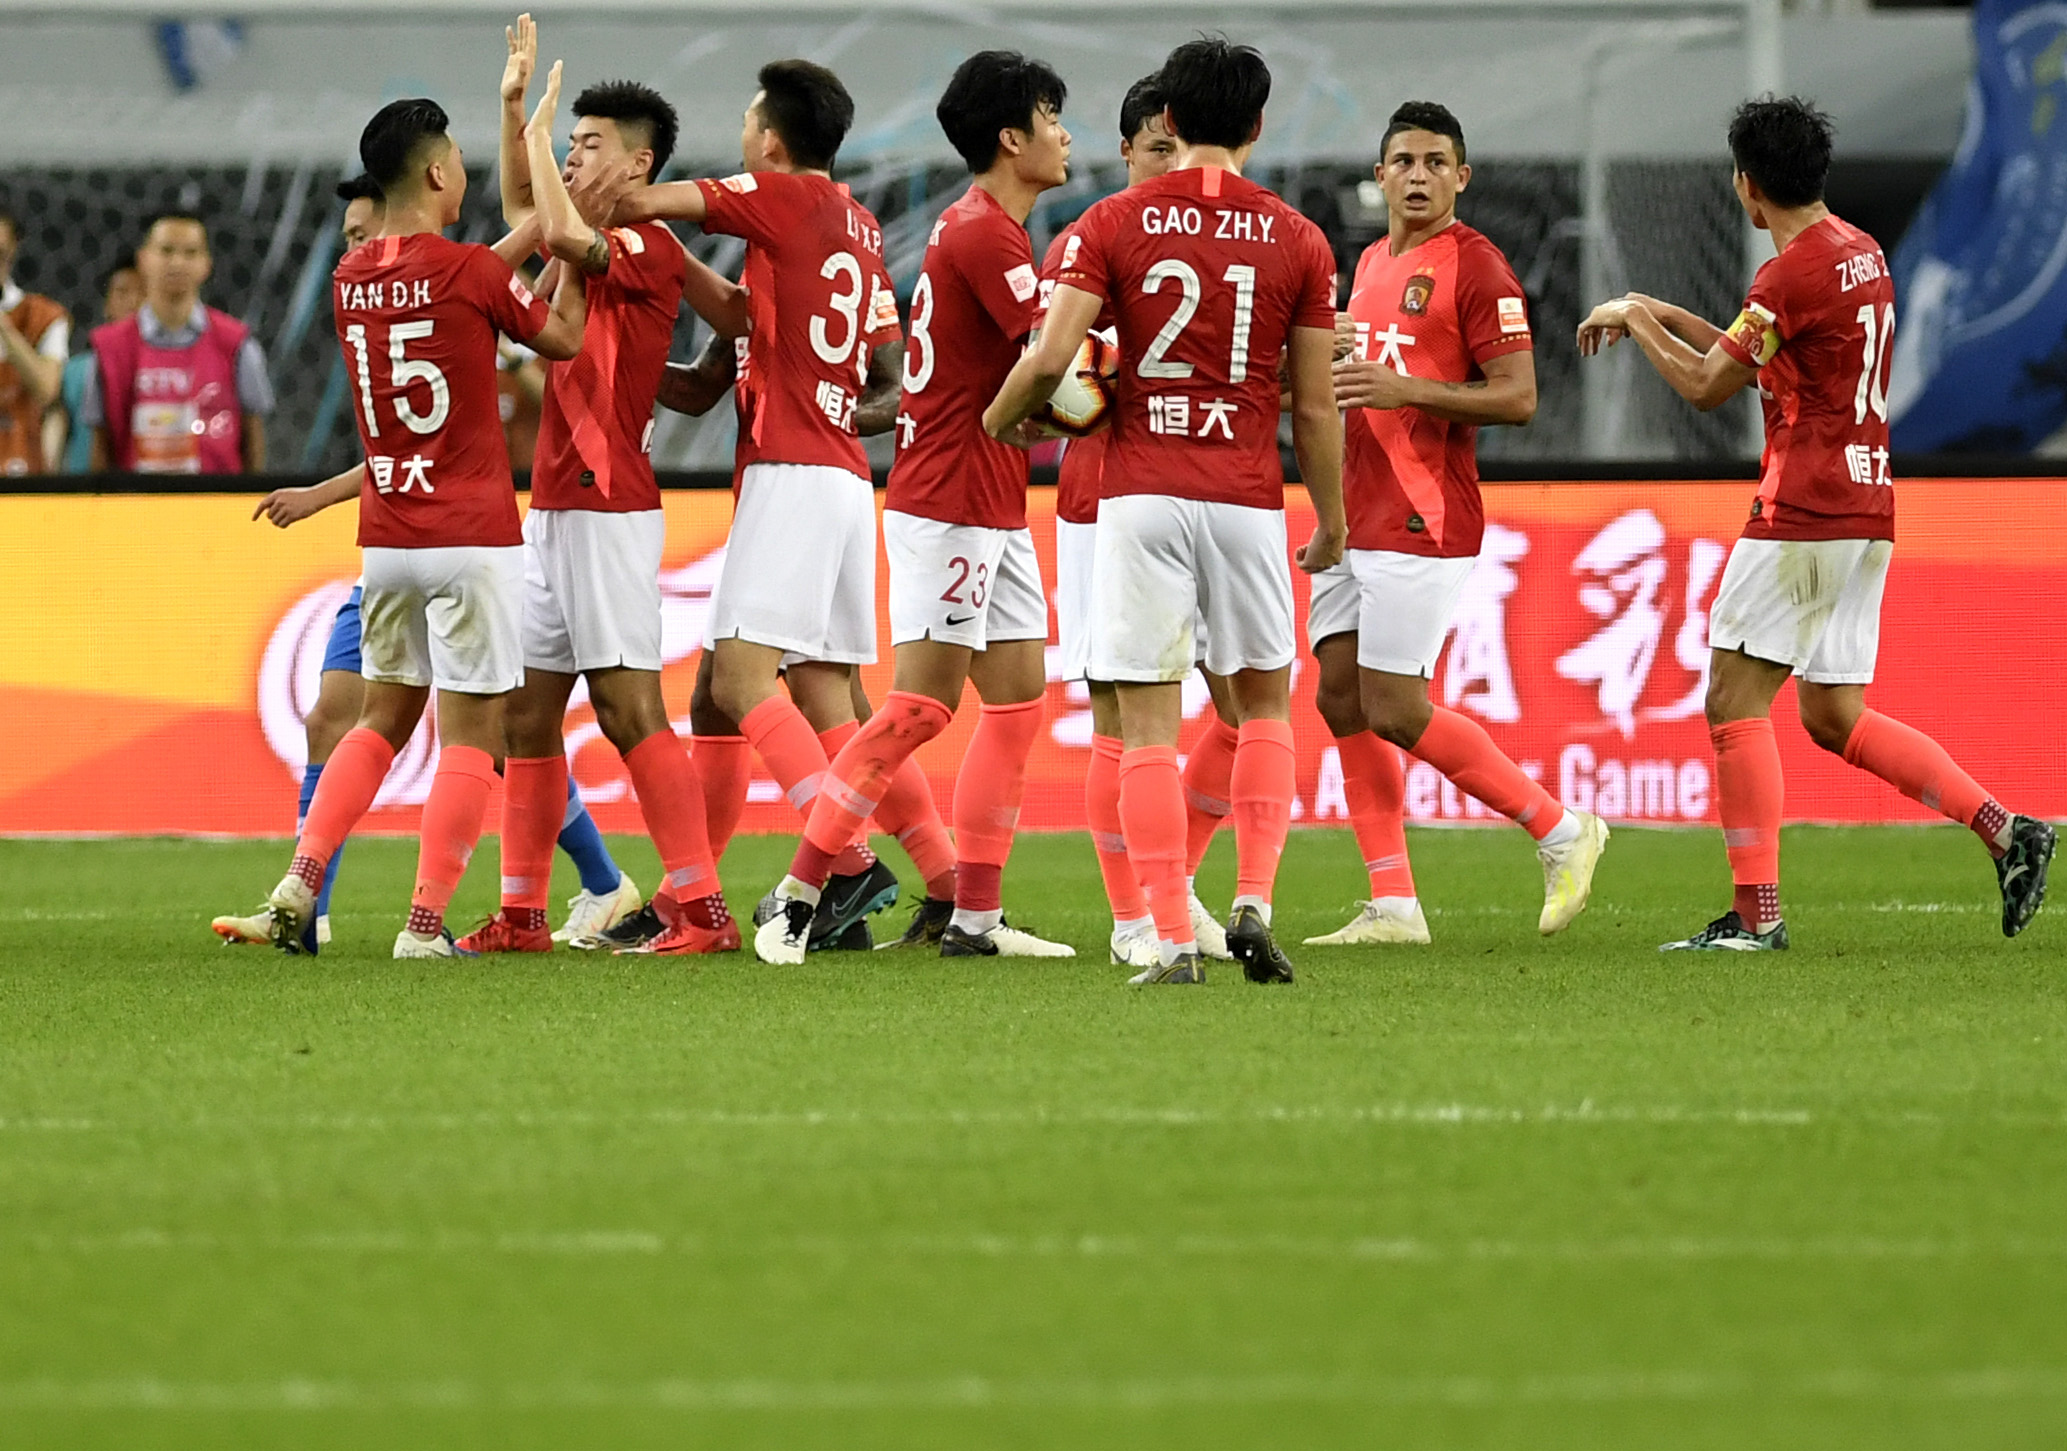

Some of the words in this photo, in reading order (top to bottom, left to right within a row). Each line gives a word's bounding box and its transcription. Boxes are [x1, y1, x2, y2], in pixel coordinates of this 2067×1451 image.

[846, 209, 859, 242] LI
[1142, 206, 1202, 235] GAO
[1214, 210, 1276, 244] ZH.Y.
[1835, 252, 1881, 293] ZHENG
[340, 282, 384, 310] YAN
[902, 272, 935, 394] 3
[1137, 259, 1256, 384] 21
[345, 319, 450, 437] 15
[1854, 301, 1895, 425] 10
[897, 412, 917, 449] 大
[1148, 395, 1238, 440] 恒大
[368, 454, 434, 494] 恒大
[1844, 444, 1892, 486] 恒大
[939, 556, 988, 609] 23
[1559, 743, 1713, 819] Game
